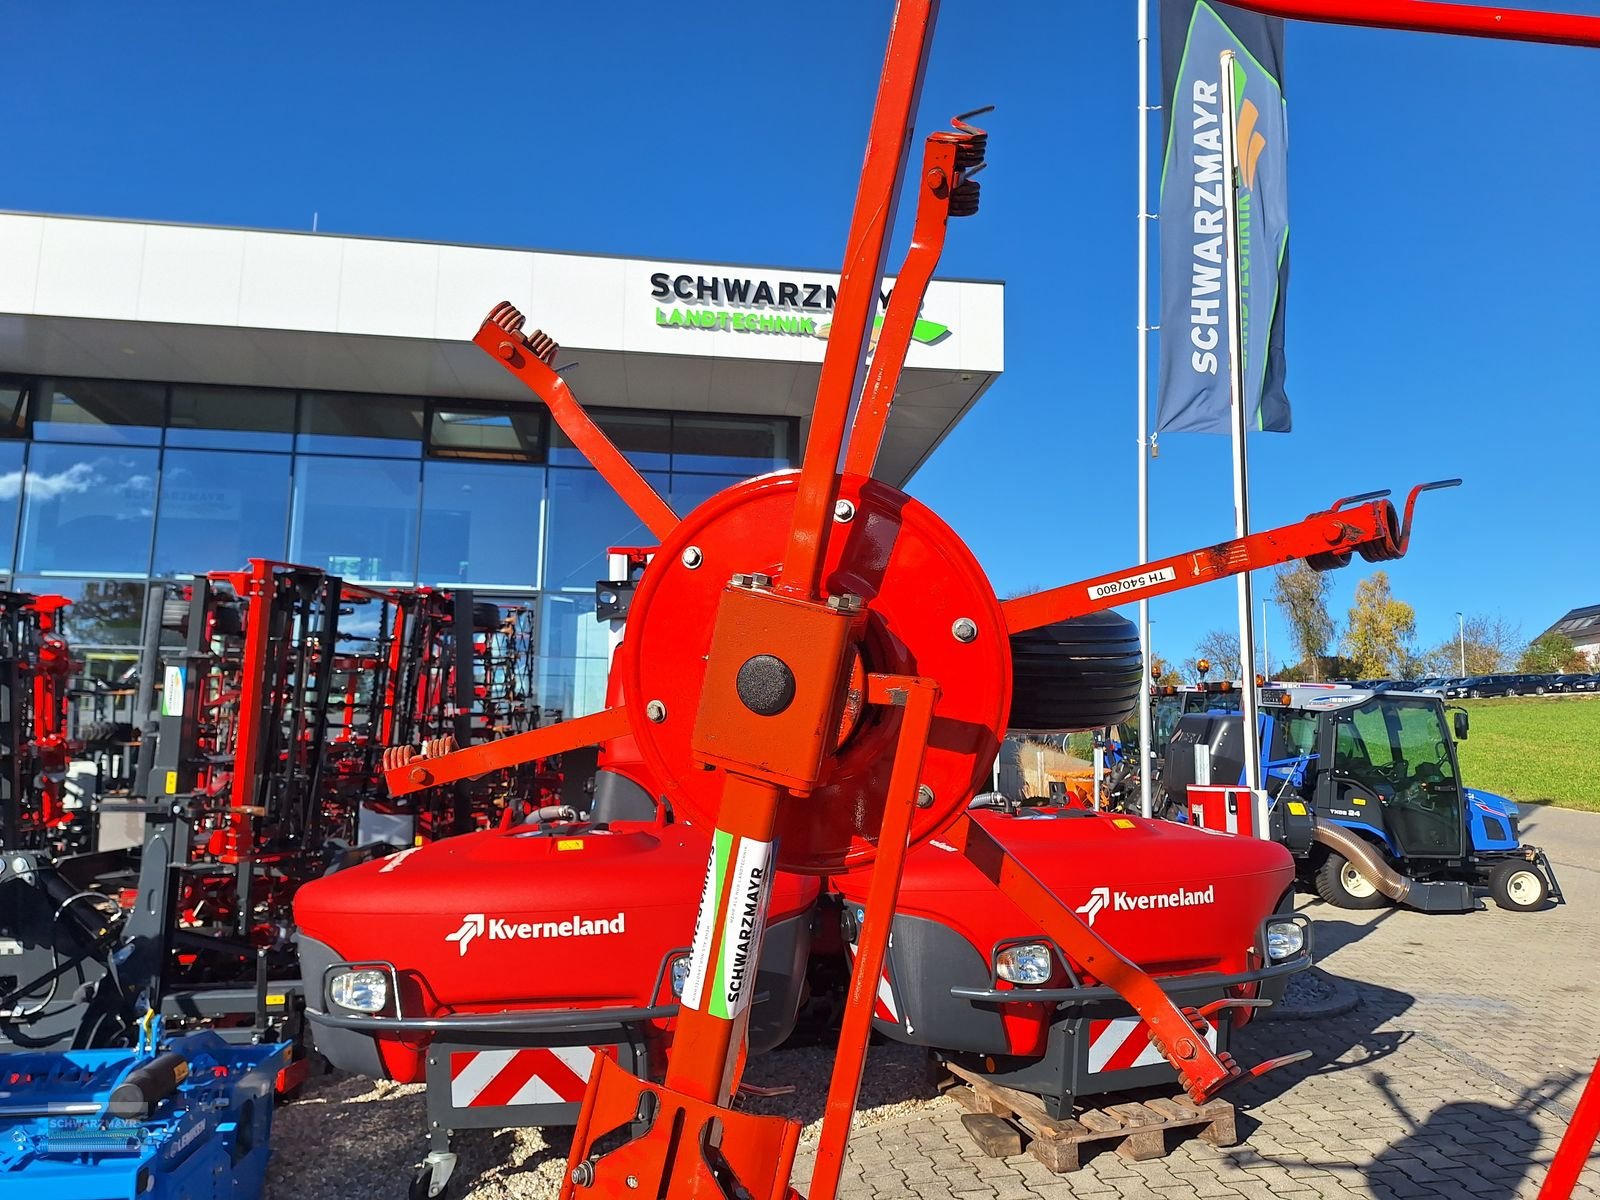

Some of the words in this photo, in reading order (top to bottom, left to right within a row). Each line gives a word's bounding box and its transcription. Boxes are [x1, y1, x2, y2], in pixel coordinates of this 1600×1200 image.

[1190, 79, 1223, 375] SCHWARZMAYR
[650, 272, 893, 310] SCHWARZY
[656, 306, 815, 333] LANDTECHNIK
[1097, 577, 1146, 596] 540/800
[1149, 571, 1166, 583] TH
[1113, 885, 1215, 911] Kverneland
[488, 912, 625, 940] Kverneland
[728, 867, 763, 1003] SCHWARZMAYR
